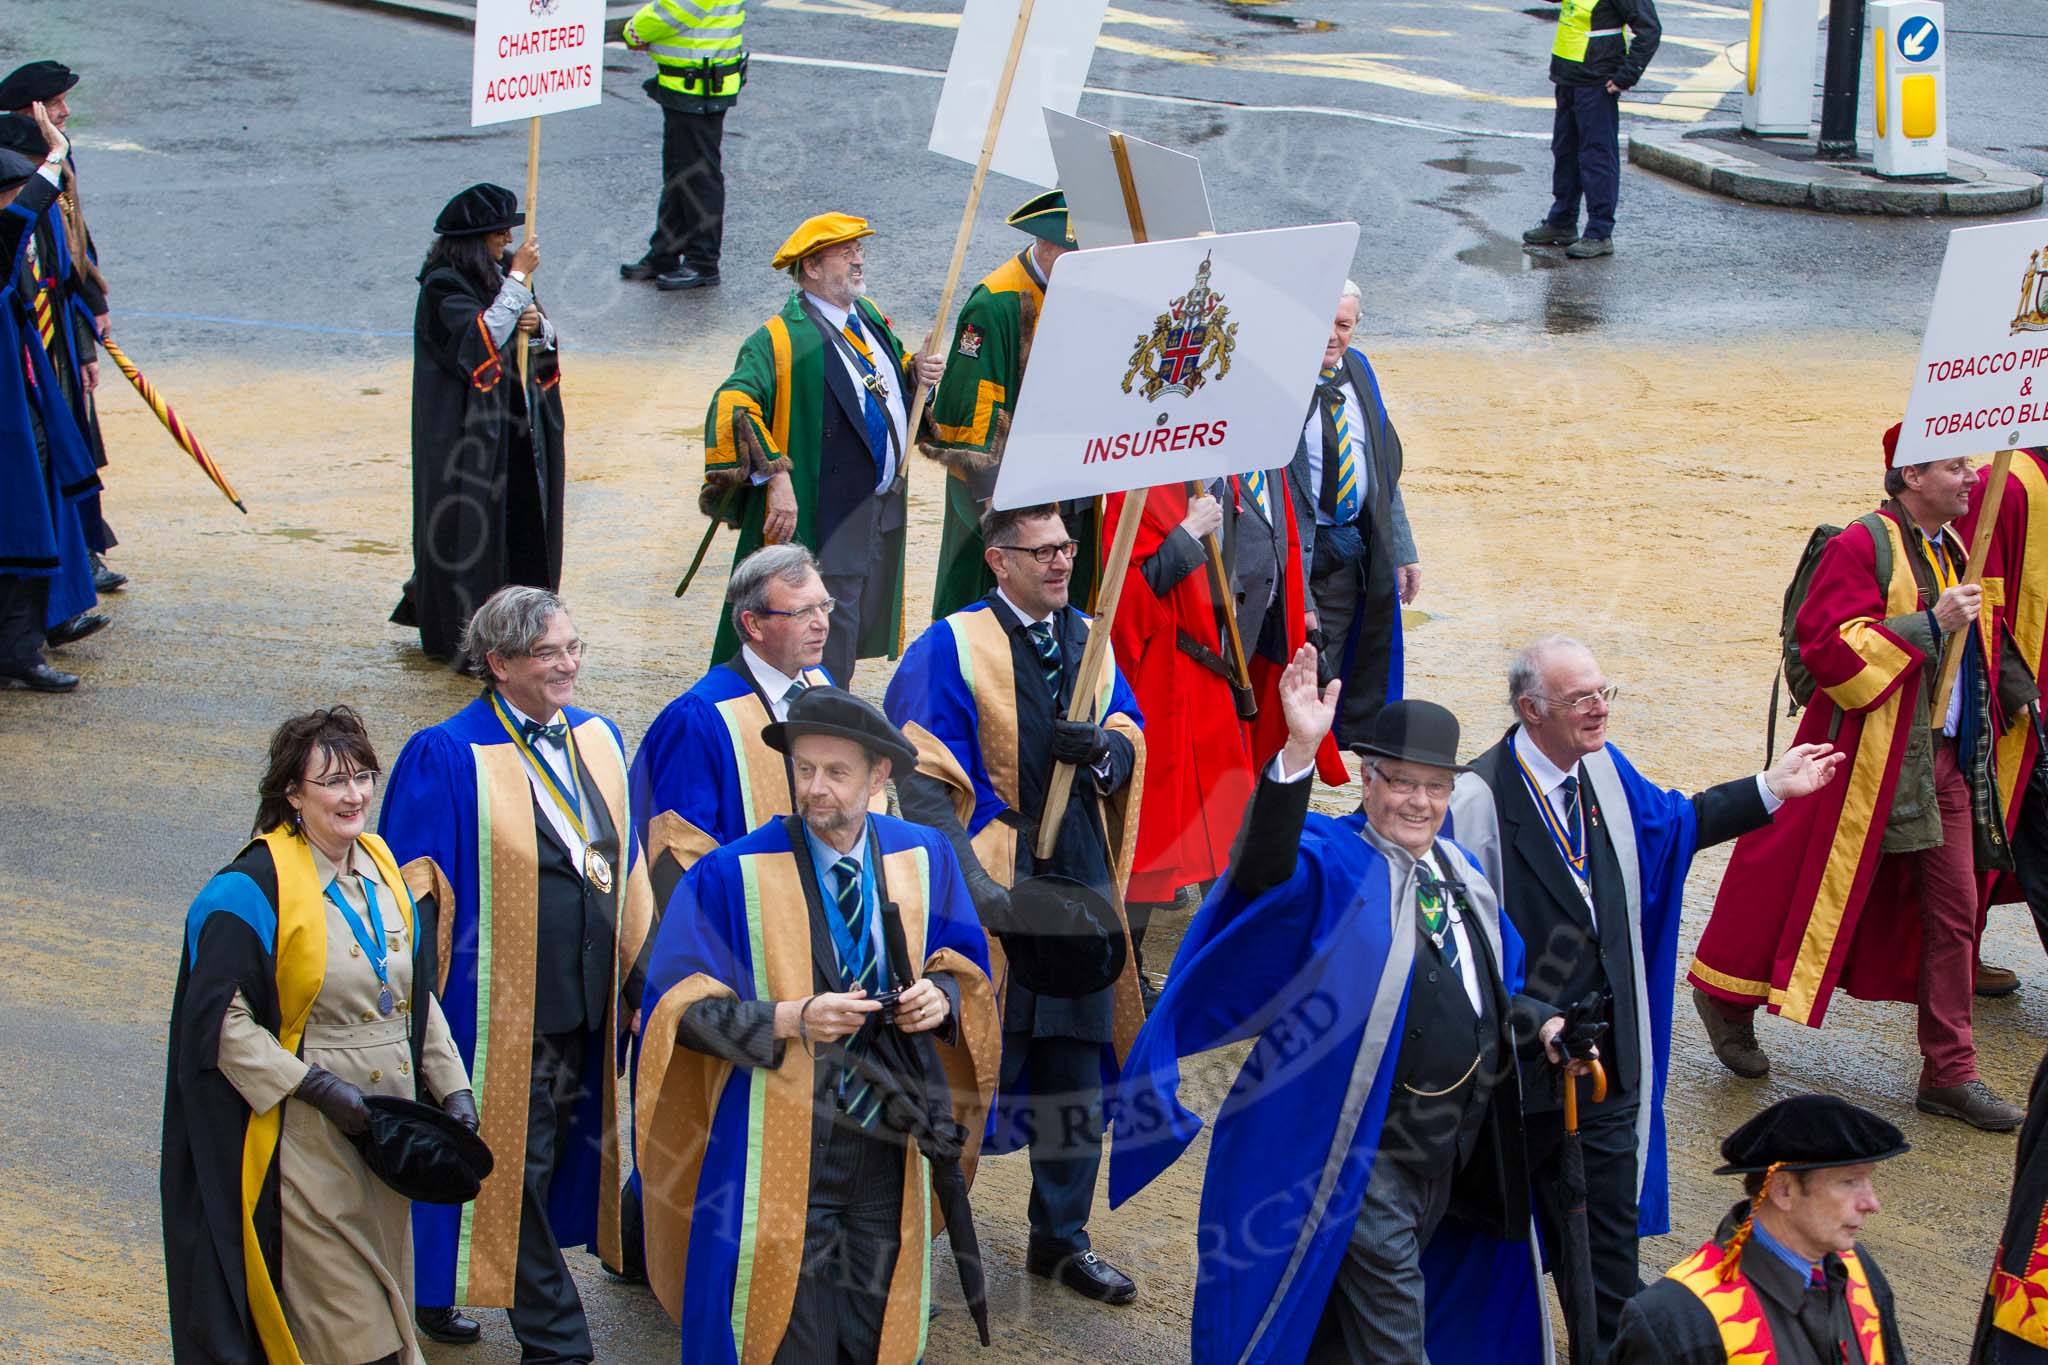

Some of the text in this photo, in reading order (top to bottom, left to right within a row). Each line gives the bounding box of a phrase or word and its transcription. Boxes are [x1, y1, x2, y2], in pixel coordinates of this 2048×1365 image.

[498, 24, 585, 58] CHARTERED
[485, 64, 592, 103] ACCOUNTANTS
[1927, 352, 2017, 383] TOBACCO
[2020, 377, 2032, 396] &
[1925, 406, 2015, 437] TOBACCO
[1083, 420, 1227, 464] INSURERS
